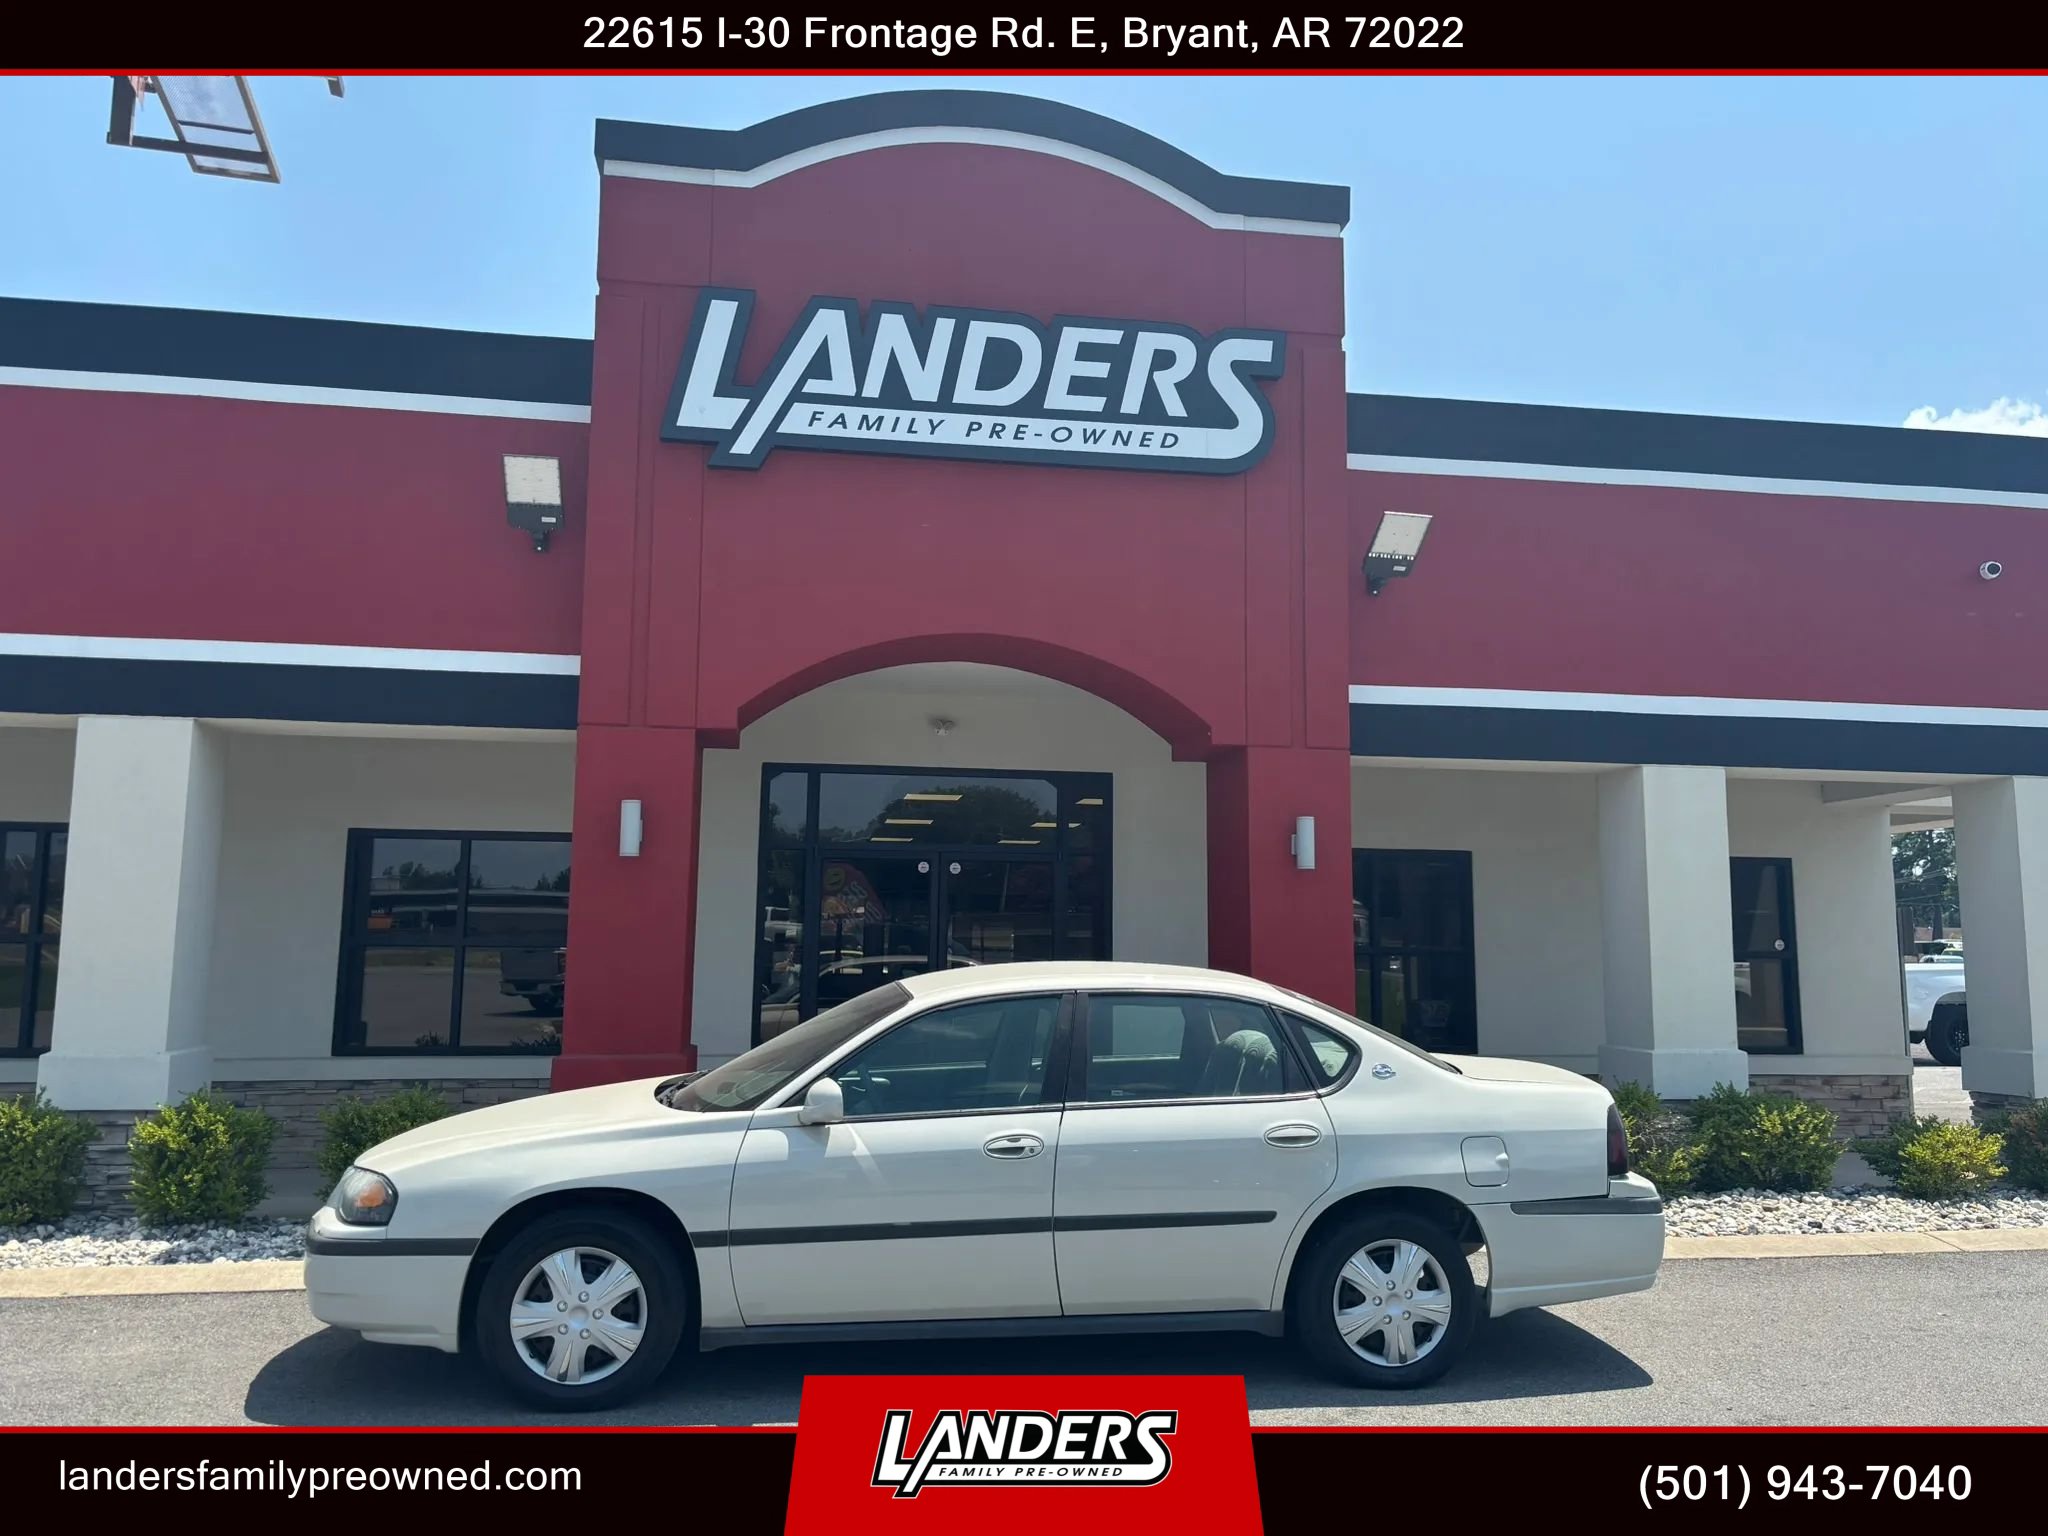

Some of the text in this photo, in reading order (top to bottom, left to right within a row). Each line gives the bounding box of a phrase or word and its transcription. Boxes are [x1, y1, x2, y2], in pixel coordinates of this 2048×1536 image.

[676, 298, 1275, 461] LANDERS
[807, 408, 1181, 451] FAMILY PRE-OWNED
